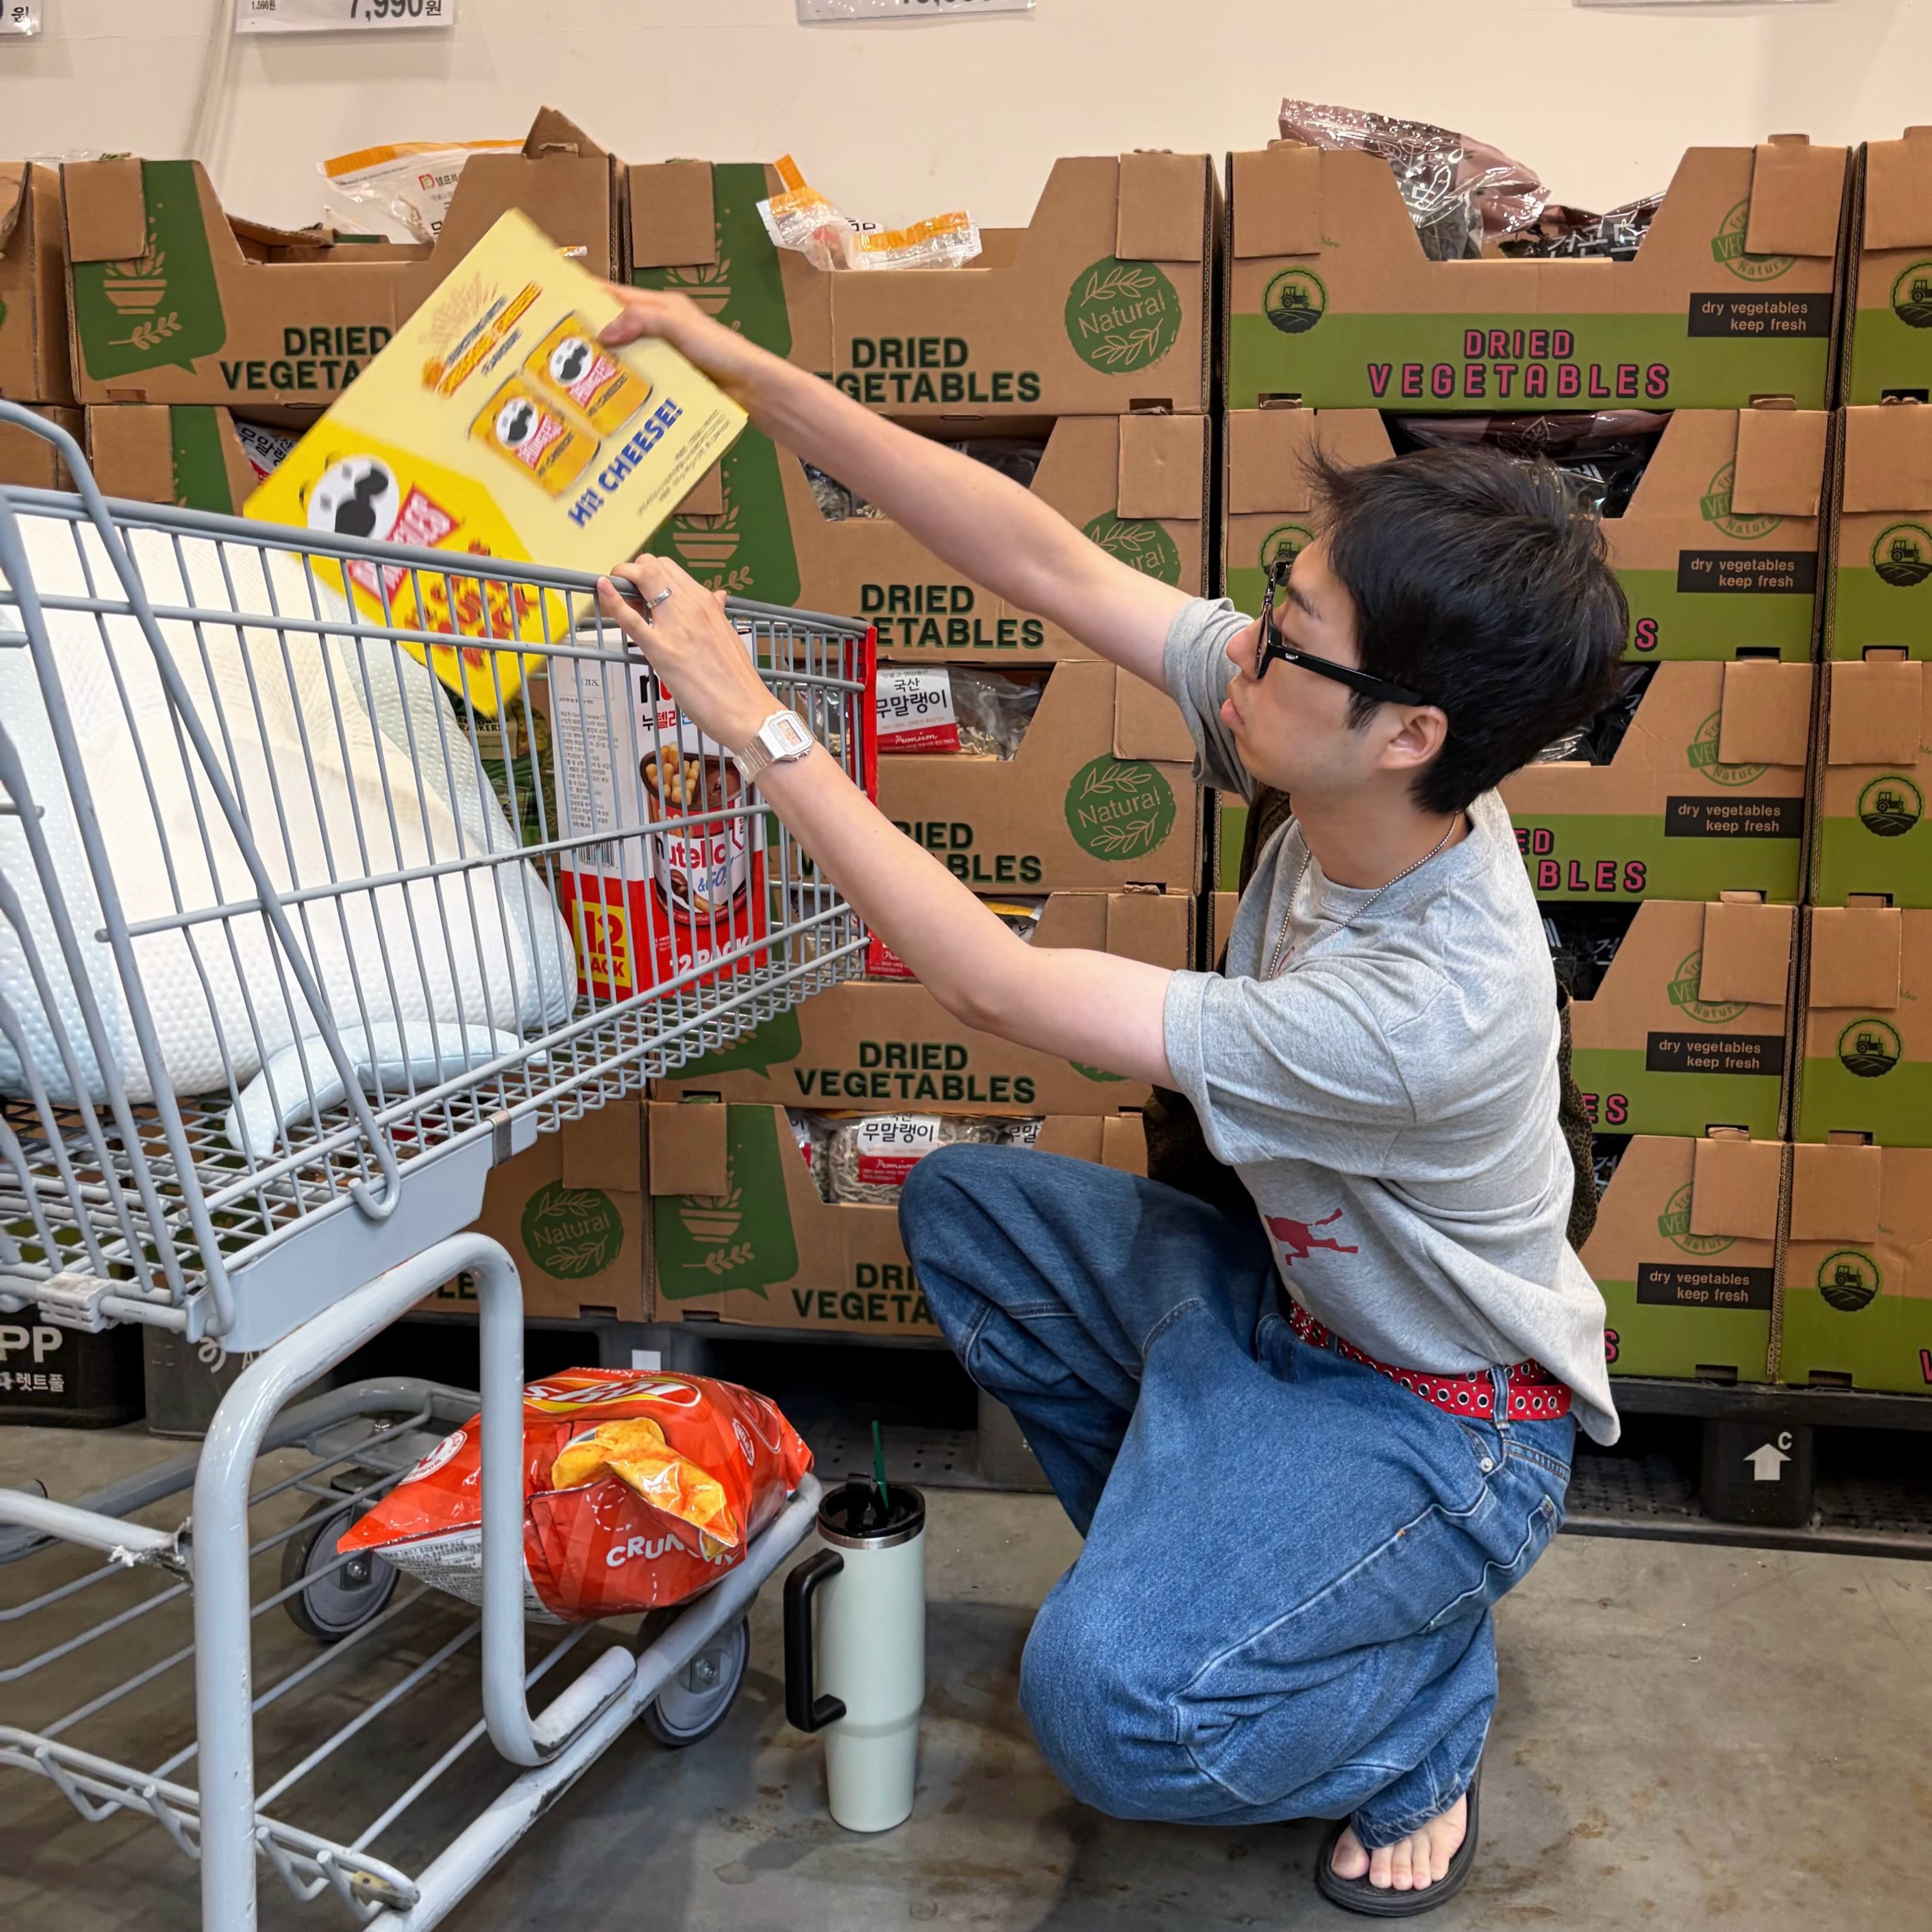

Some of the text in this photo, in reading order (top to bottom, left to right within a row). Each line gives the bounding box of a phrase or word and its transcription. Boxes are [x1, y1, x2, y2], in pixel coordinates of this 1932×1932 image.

[1077, 293, 1167, 340] Natural
[1702, 301, 1808, 316] dry vegetables
[1731, 318, 1807, 333] keep fresh
[284, 326, 393, 357] DRIED
[852, 337, 969, 369] DRIED
[1464, 330, 1574, 359] DRIED
[219, 360, 362, 391] VEGETA
[1368, 363, 1670, 398] VEGETABLES
[598, 397, 684, 492] CHEESE!
[1690, 558, 1795, 572] dry vegetables
[1719, 575, 1794, 589] keep fresh
[860, 584, 975, 614] DRIED
[894, 678, 920, 693] 국산
[877, 689, 947, 719] 무말랭이
[1077, 787, 1161, 830] Natural
[1678, 804, 1781, 818] dry vegetables
[1706, 819, 1779, 833] keep fresh
[584, 910, 625, 958] 12
[859, 1040, 969, 1071] DRIED
[1658, 1040, 1761, 1054] dry vegetables
[1687, 1056, 1760, 1069] keep fresh
[794, 1068, 1036, 1104] VEGETABLES
[863, 1123, 934, 1143] 무말랭이
[533, 1209, 611, 1247] Natural
[856, 1263, 916, 1291] DRI
[1650, 1271, 1750, 1285] dry vegetables
[791, 1289, 936, 1324] VEGETA
[1677, 1287, 1748, 1302] keep fresh
[1778, 1432, 1793, 1450] C
